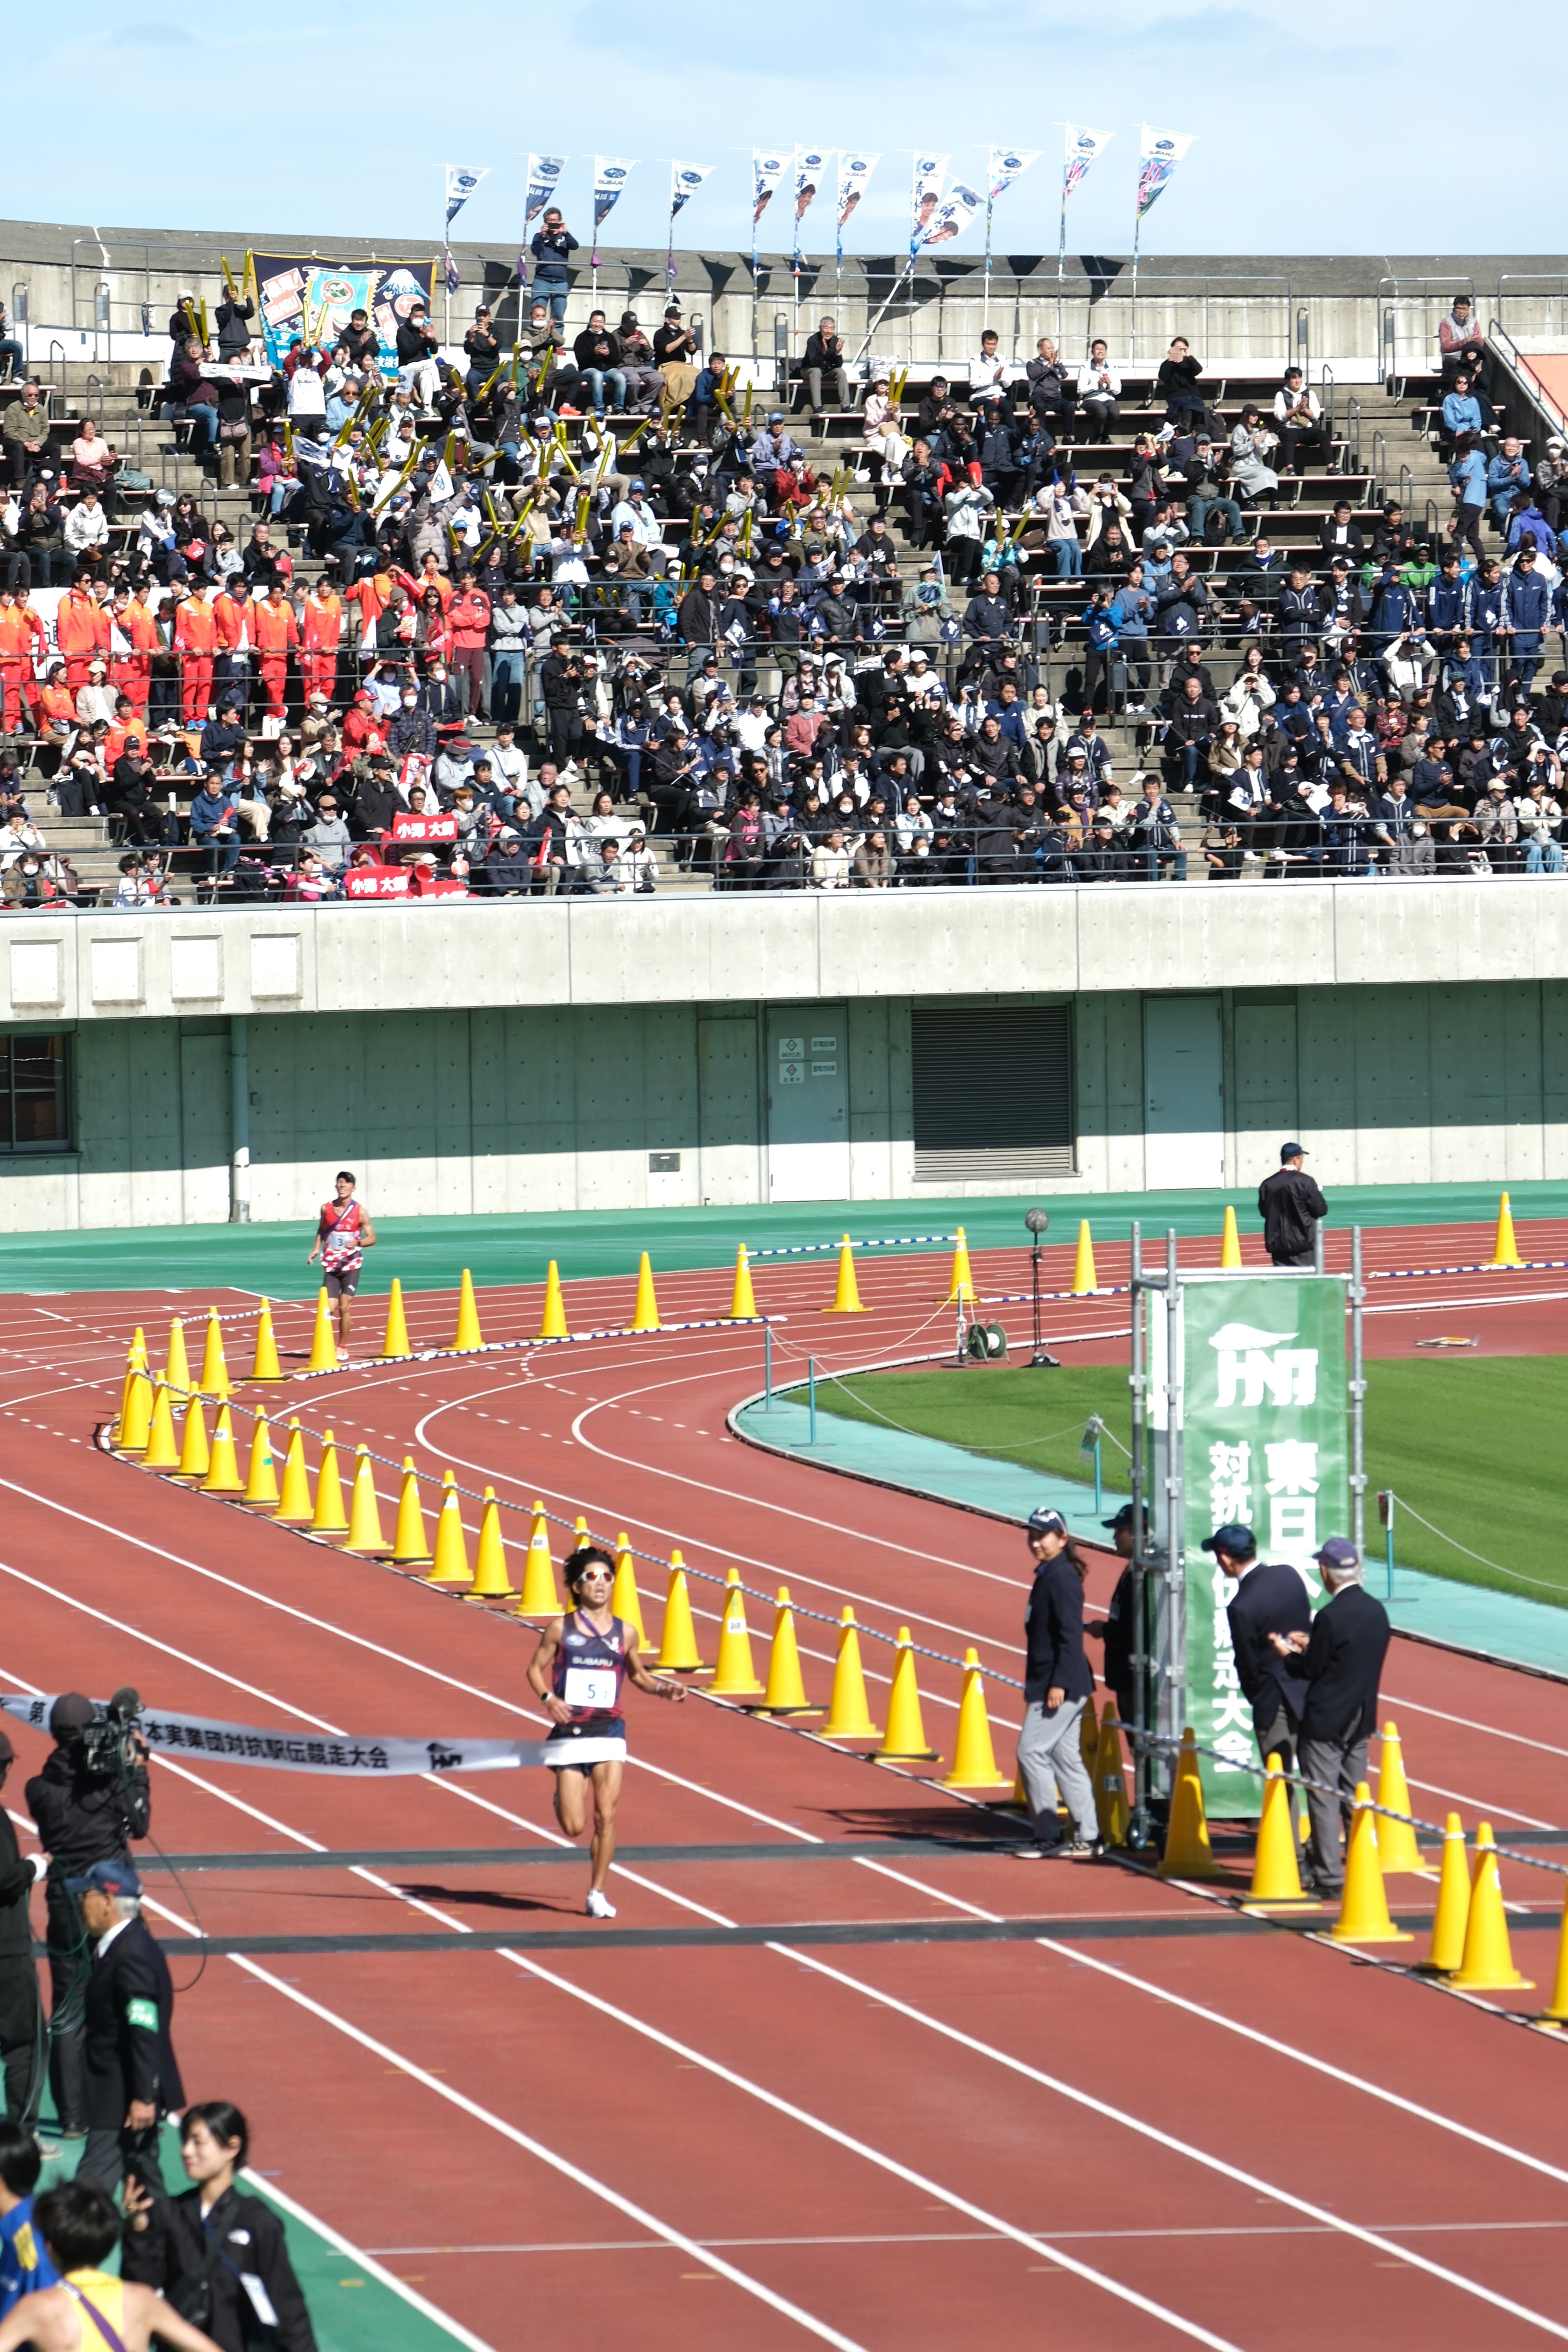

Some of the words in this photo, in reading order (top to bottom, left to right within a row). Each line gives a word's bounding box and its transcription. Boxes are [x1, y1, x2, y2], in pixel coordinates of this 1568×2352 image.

[338, 1238, 343, 1246] 3
[572, 1655, 613, 1667] SUBARU
[587, 1684, 596, 1699] 5
